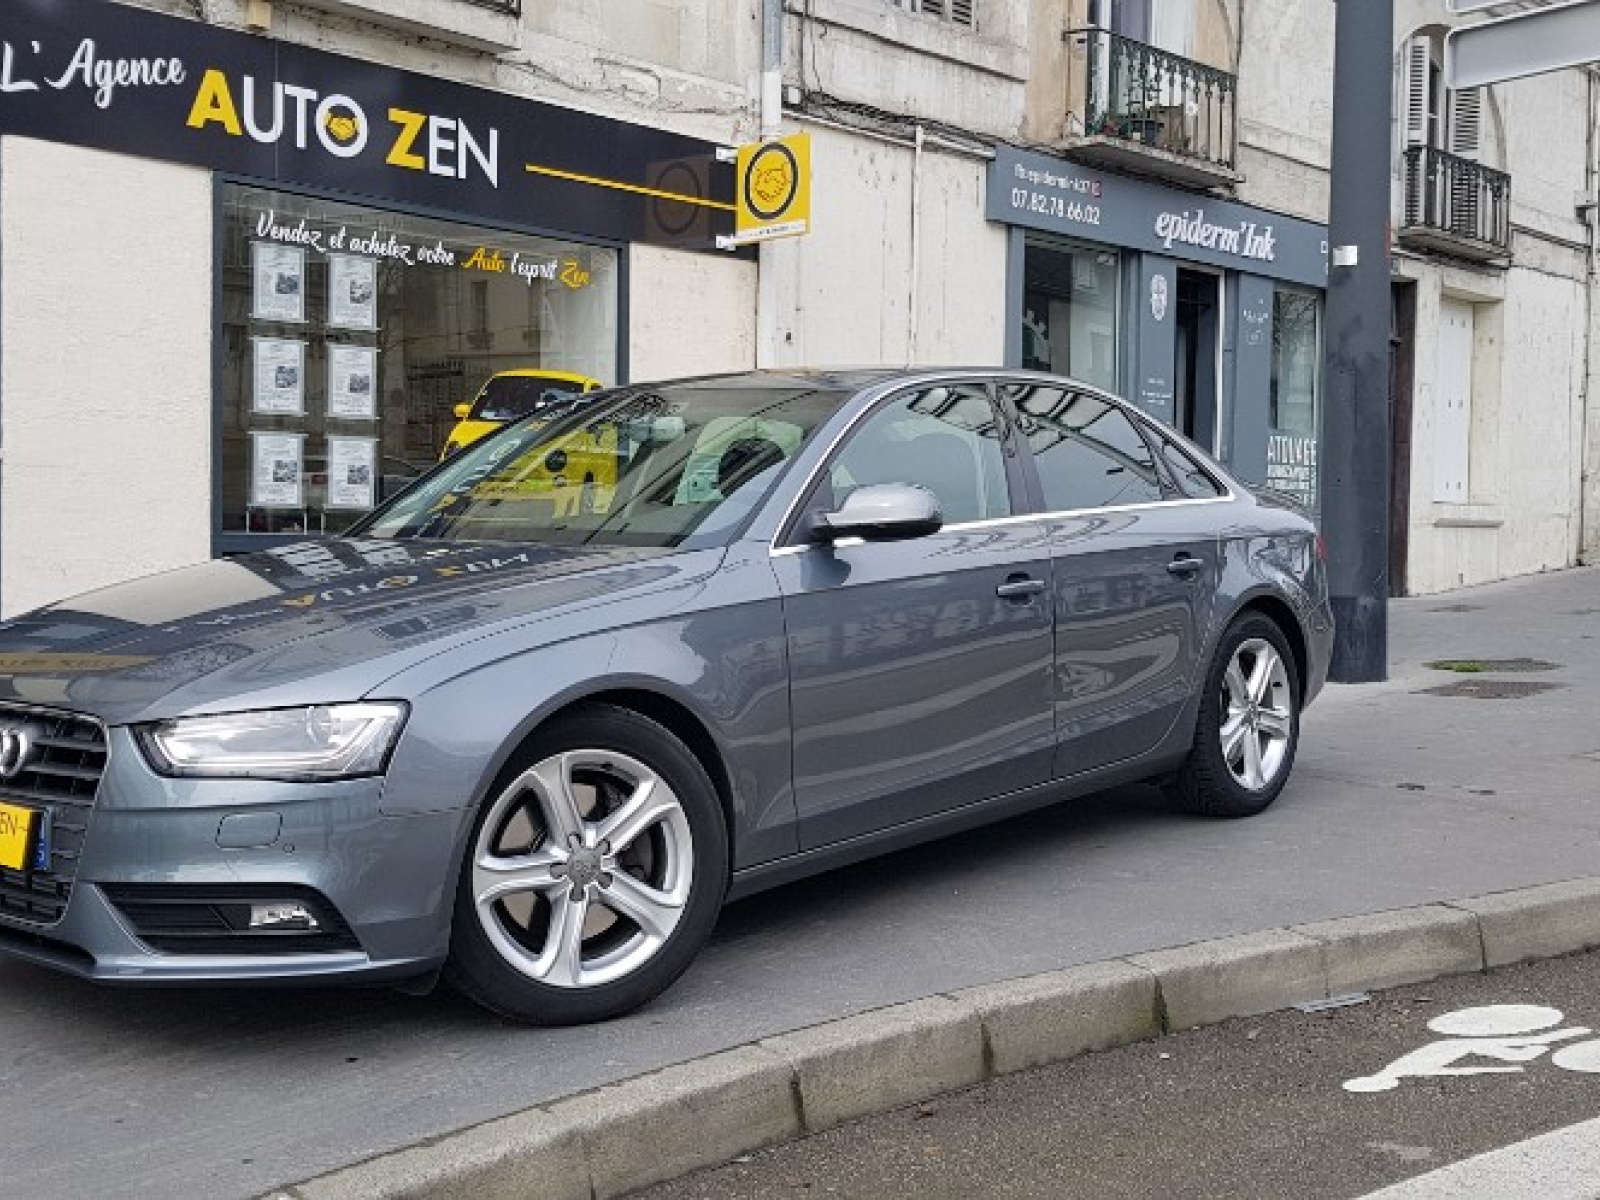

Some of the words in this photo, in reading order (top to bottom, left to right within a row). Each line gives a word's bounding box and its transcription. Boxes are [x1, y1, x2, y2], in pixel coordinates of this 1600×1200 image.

[0, 38, 187, 108] L'Agence
[185, 69, 369, 158] AUTO
[385, 108, 499, 189] ZEN
[256, 209, 326, 253] Vendez
[330, 226, 346, 249] et
[349, 230, 415, 266] achetez
[416, 240, 455, 266] votre
[461, 246, 505, 273] Auto
[1154, 209, 1276, 261] epiderm'Ink
